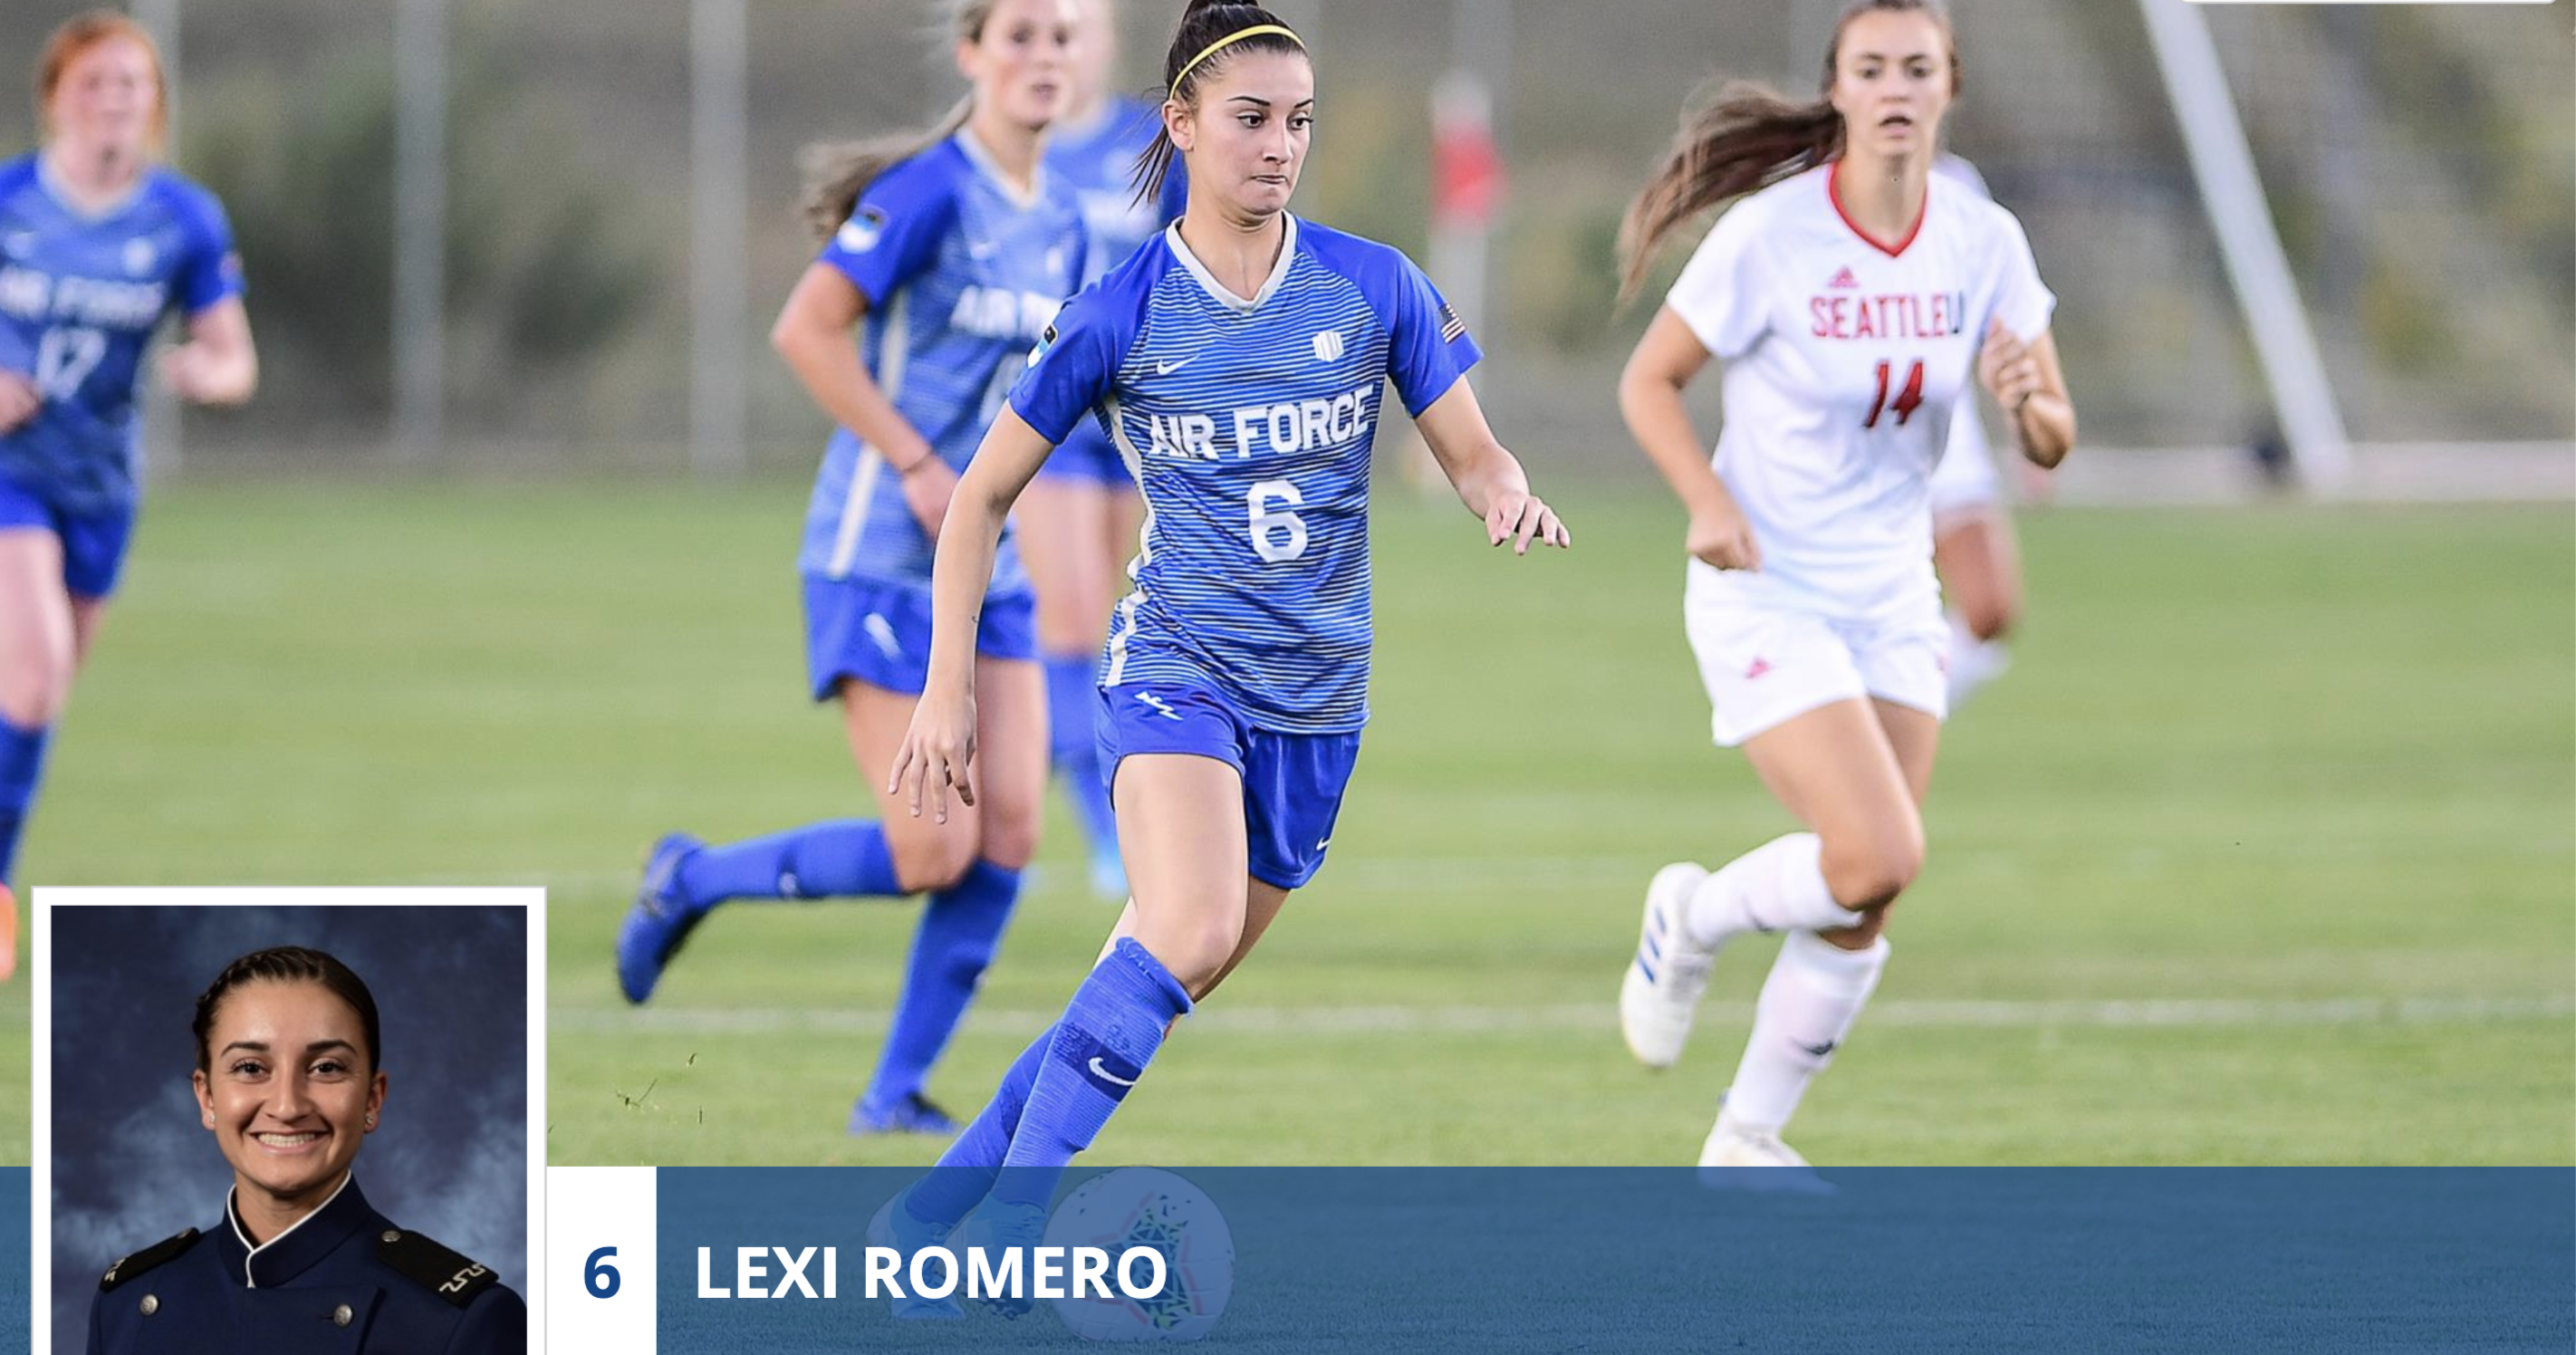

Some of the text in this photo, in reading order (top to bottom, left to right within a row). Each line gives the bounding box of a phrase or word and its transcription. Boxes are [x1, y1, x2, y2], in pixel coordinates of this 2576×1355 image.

[1148, 384, 1374, 460] AIR FORCE
[1861, 359, 1924, 428] 14
[1246, 478, 1308, 563] 6
